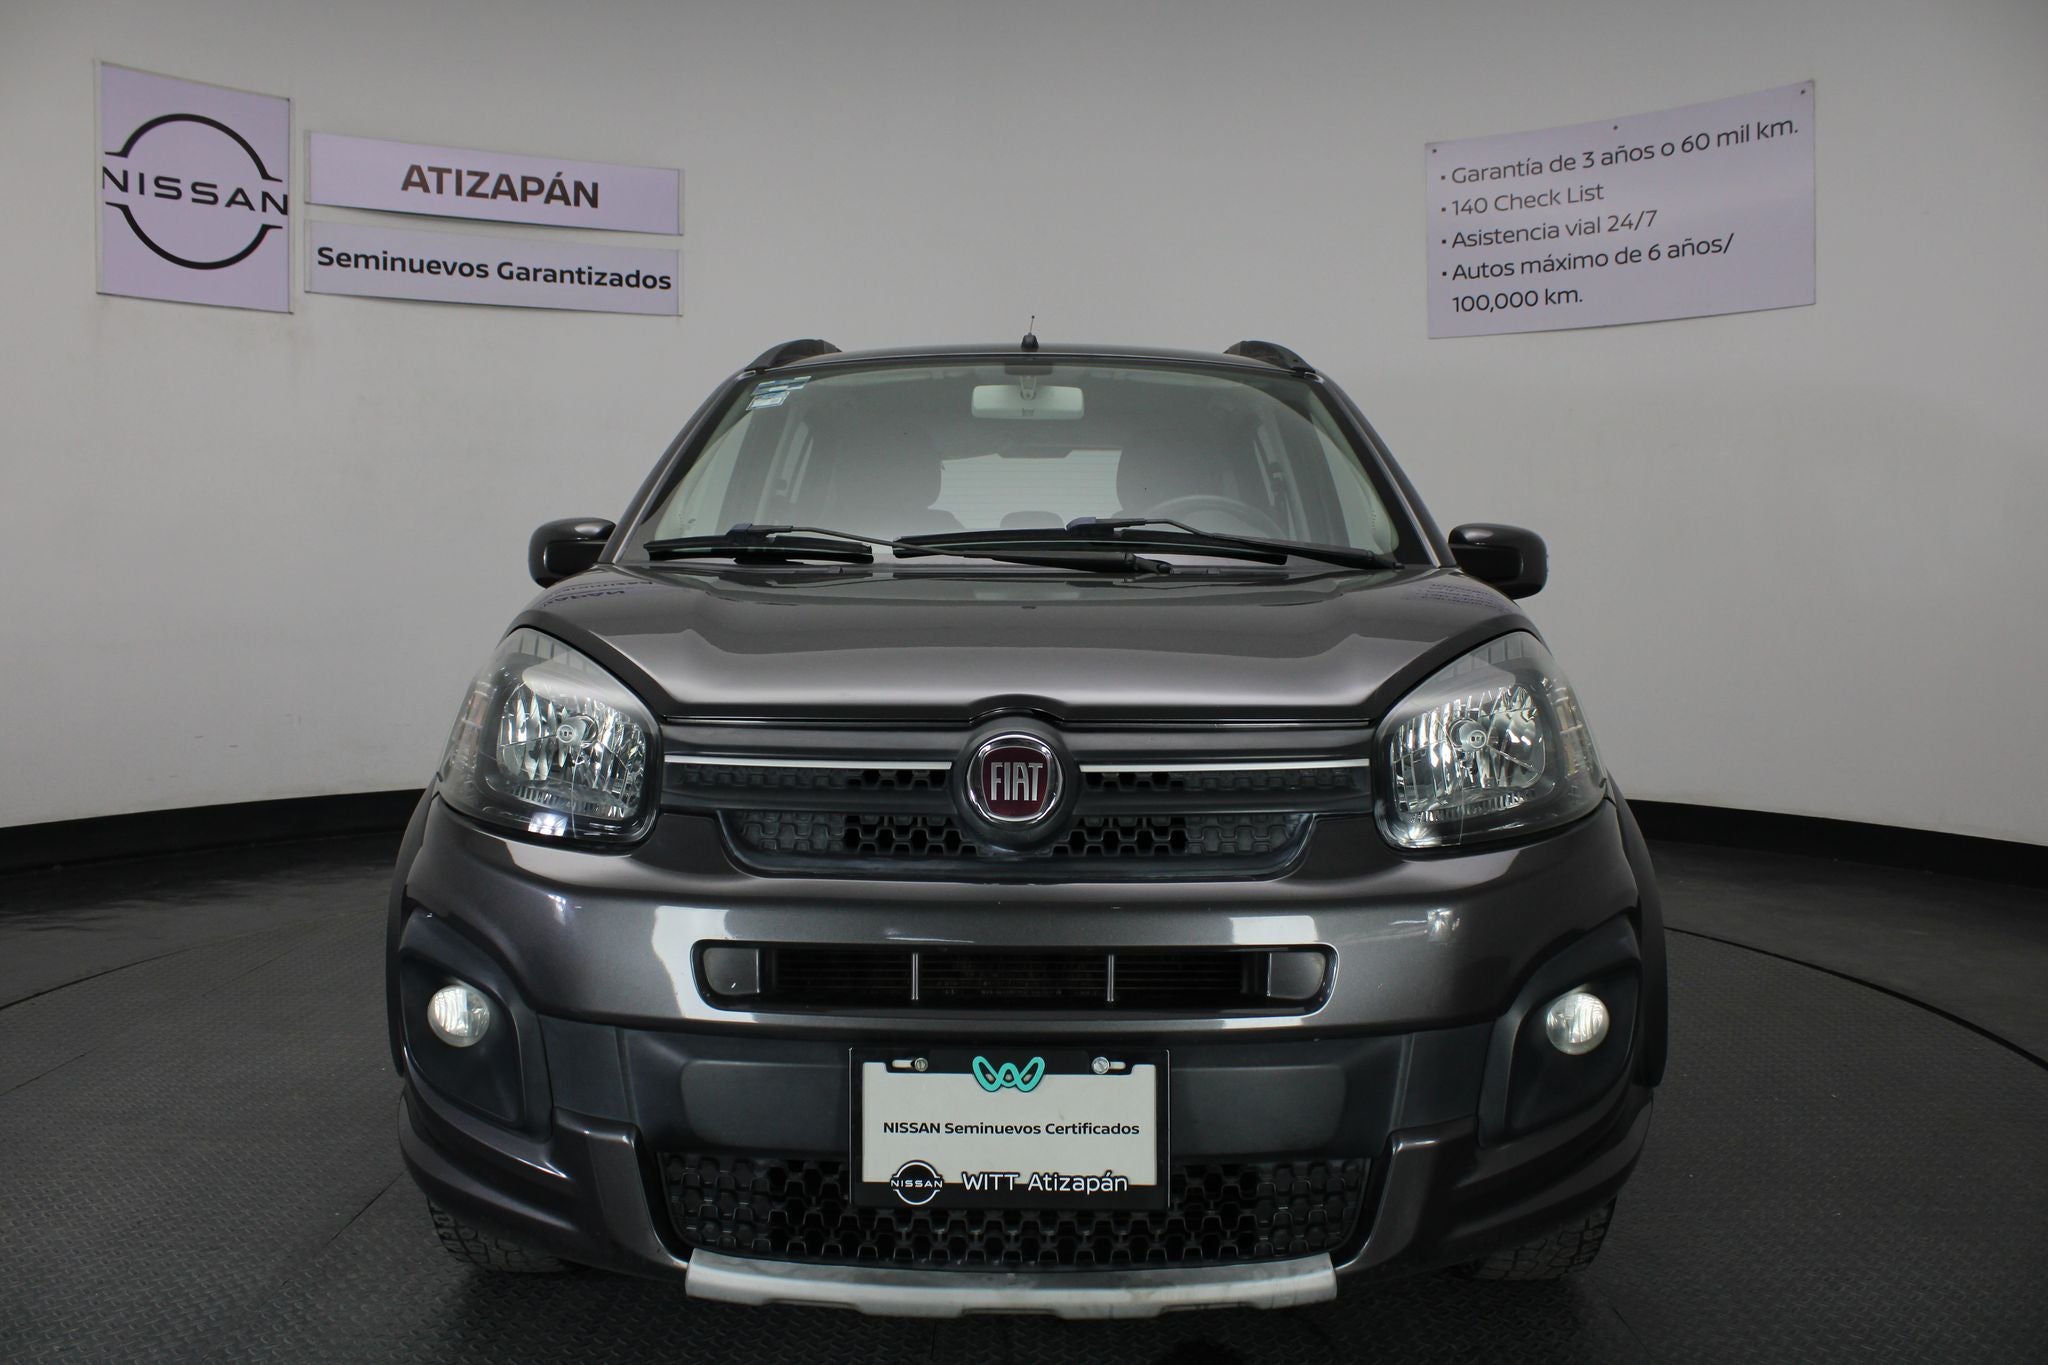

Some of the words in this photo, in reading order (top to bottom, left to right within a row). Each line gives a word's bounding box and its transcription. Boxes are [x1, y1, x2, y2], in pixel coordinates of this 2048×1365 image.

[1452, 158, 1543, 184] Garantía
[1549, 152, 1576, 172] de
[1582, 152, 1595, 169] 3
[1601, 145, 1655, 166] años
[1661, 142, 1674, 157] o
[1681, 133, 1710, 153] 60
[1717, 124, 1750, 146] mil
[1757, 118, 1798, 141] km.
[102, 166, 288, 216] NISSAN
[401, 164, 599, 209] ATIZAPÁN
[1452, 197, 1488, 216] 140
[1494, 189, 1561, 212] Check
[1567, 183, 1604, 203] List
[1452, 222, 1560, 248] Asistencia
[1566, 217, 1601, 237] vial
[1607, 209, 1658, 232] 24/7
[317, 246, 489, 279] Seminuevos
[497, 262, 672, 292] Garantizados
[1452, 259, 1515, 281] Autos
[1521, 250, 1609, 274] máximo
[1615, 247, 1642, 265] de
[1648, 244, 1661, 261] 6
[1668, 233, 1734, 258] años/
[1452, 290, 1539, 313] 100,000
[1545, 287, 1583, 305] km.
[991, 762, 1043, 801] FIAT
[883, 1123, 940, 1134] NISSAN
[945, 1122, 1041, 1134] Seminuevos
[1045, 1122, 1140, 1135] Certificados
[891, 1178, 943, 1188] NISSAN
[962, 1173, 1018, 1191] WITT
[1028, 1171, 1128, 1195] Atizapán
